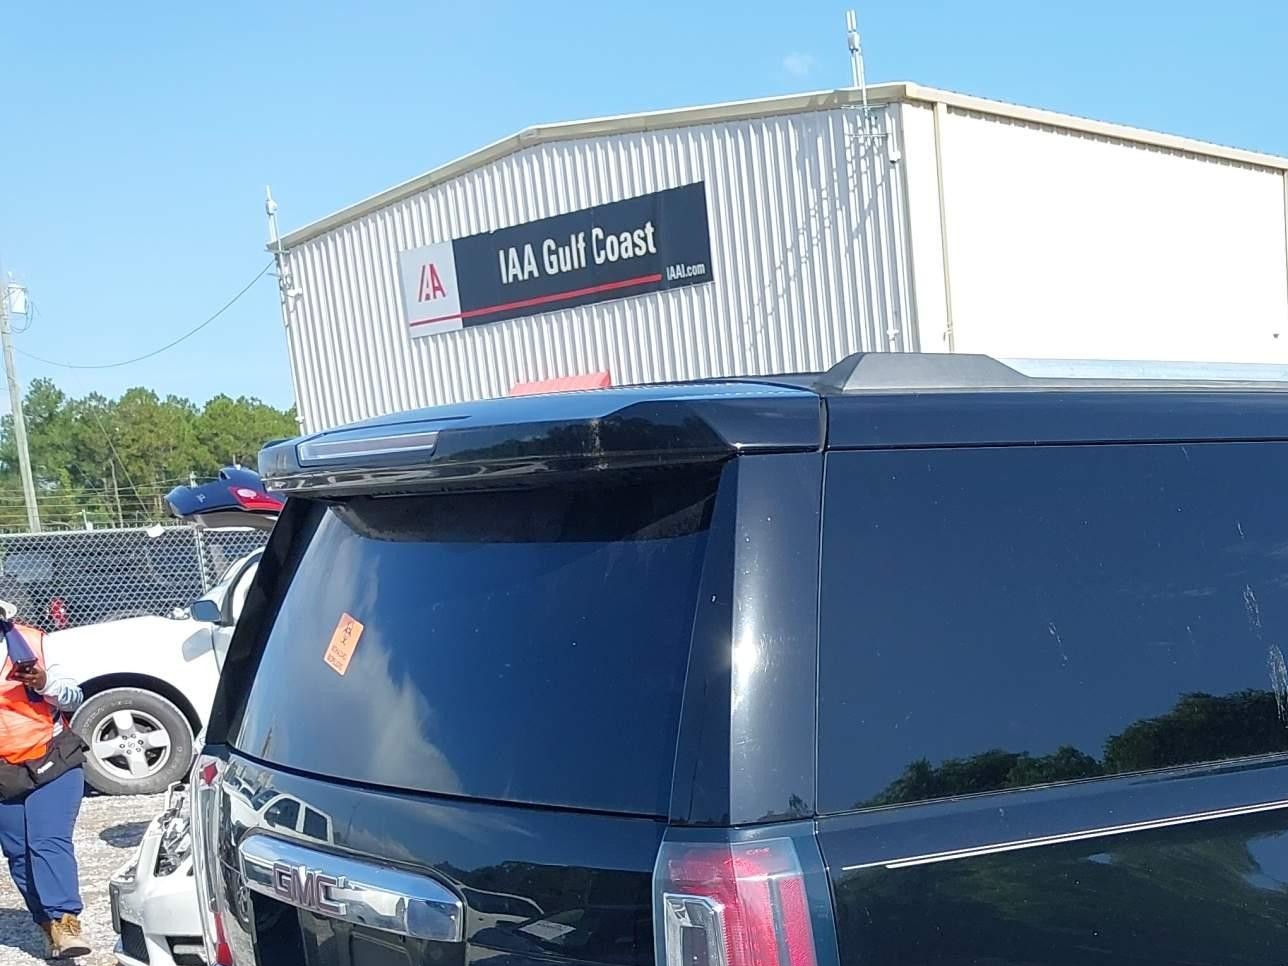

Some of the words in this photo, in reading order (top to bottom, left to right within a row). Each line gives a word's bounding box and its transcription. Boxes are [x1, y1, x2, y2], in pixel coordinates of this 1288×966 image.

[499, 243, 540, 284] IAA
[543, 231, 587, 271] Gulf
[591, 220, 657, 266] Coast
[272, 862, 347, 916] GMC
